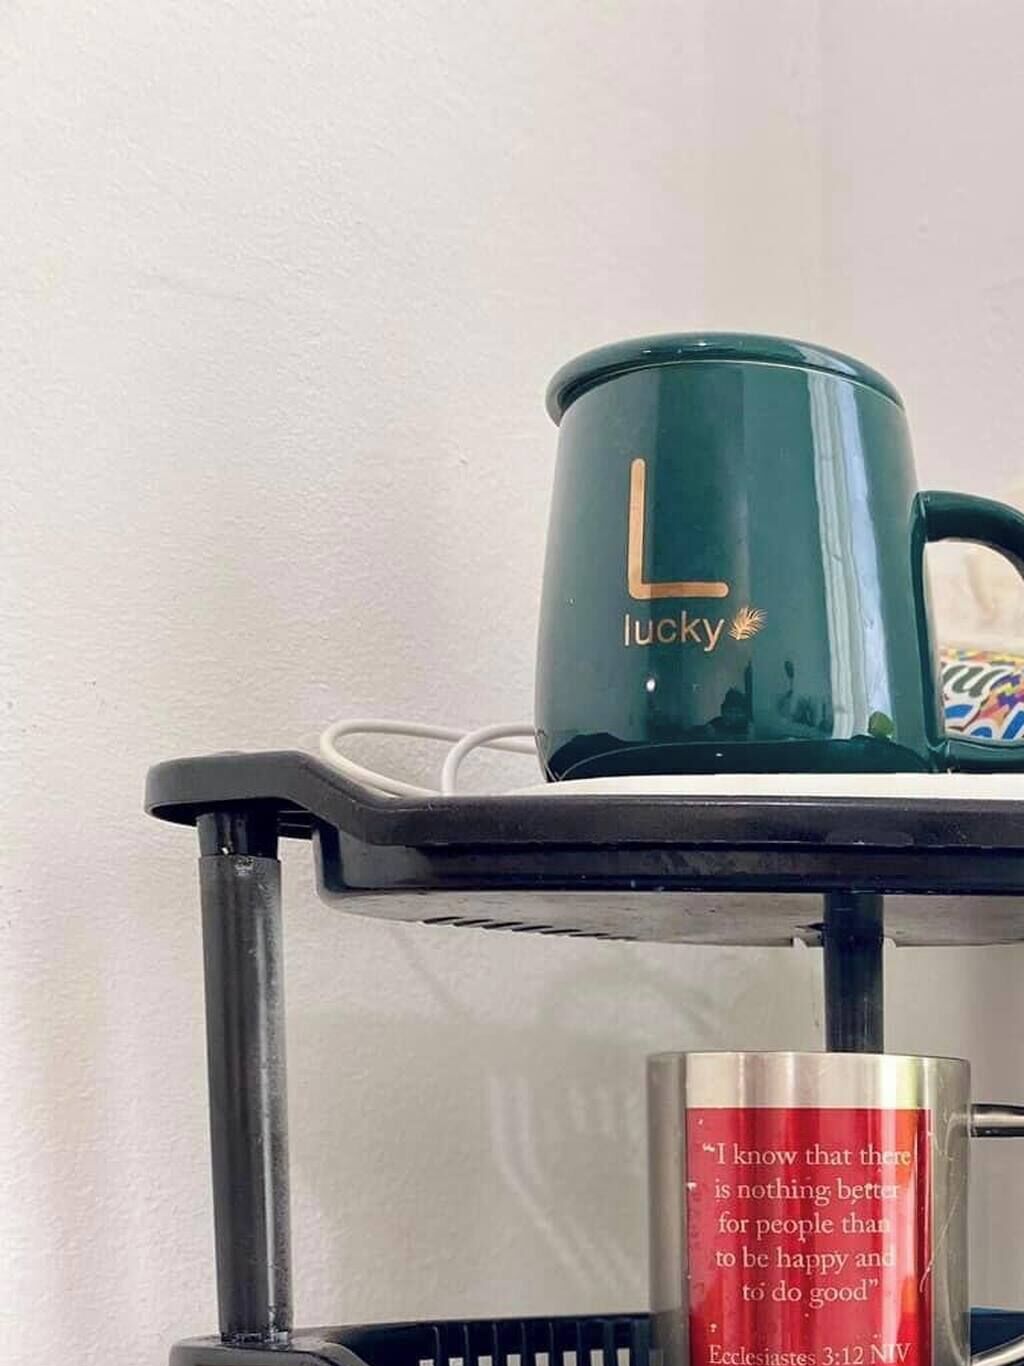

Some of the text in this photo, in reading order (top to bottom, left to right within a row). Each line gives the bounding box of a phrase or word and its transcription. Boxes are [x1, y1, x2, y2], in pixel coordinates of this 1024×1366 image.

[628, 457, 729, 600] L
[624, 610, 725, 652] lucky
[732, 1144, 798, 1165] know
[805, 1144, 853, 1166] that
[859, 1143, 912, 1166] there
[714, 1177, 901, 1206] is nothing better
[718, 1211, 892, 1240] for people than
[715, 1245, 897, 1275] to be happy and
[742, 1279, 878, 1309] to do good”
[708, 1343, 912, 1366] Ecclesiastes 3:12 NIV
